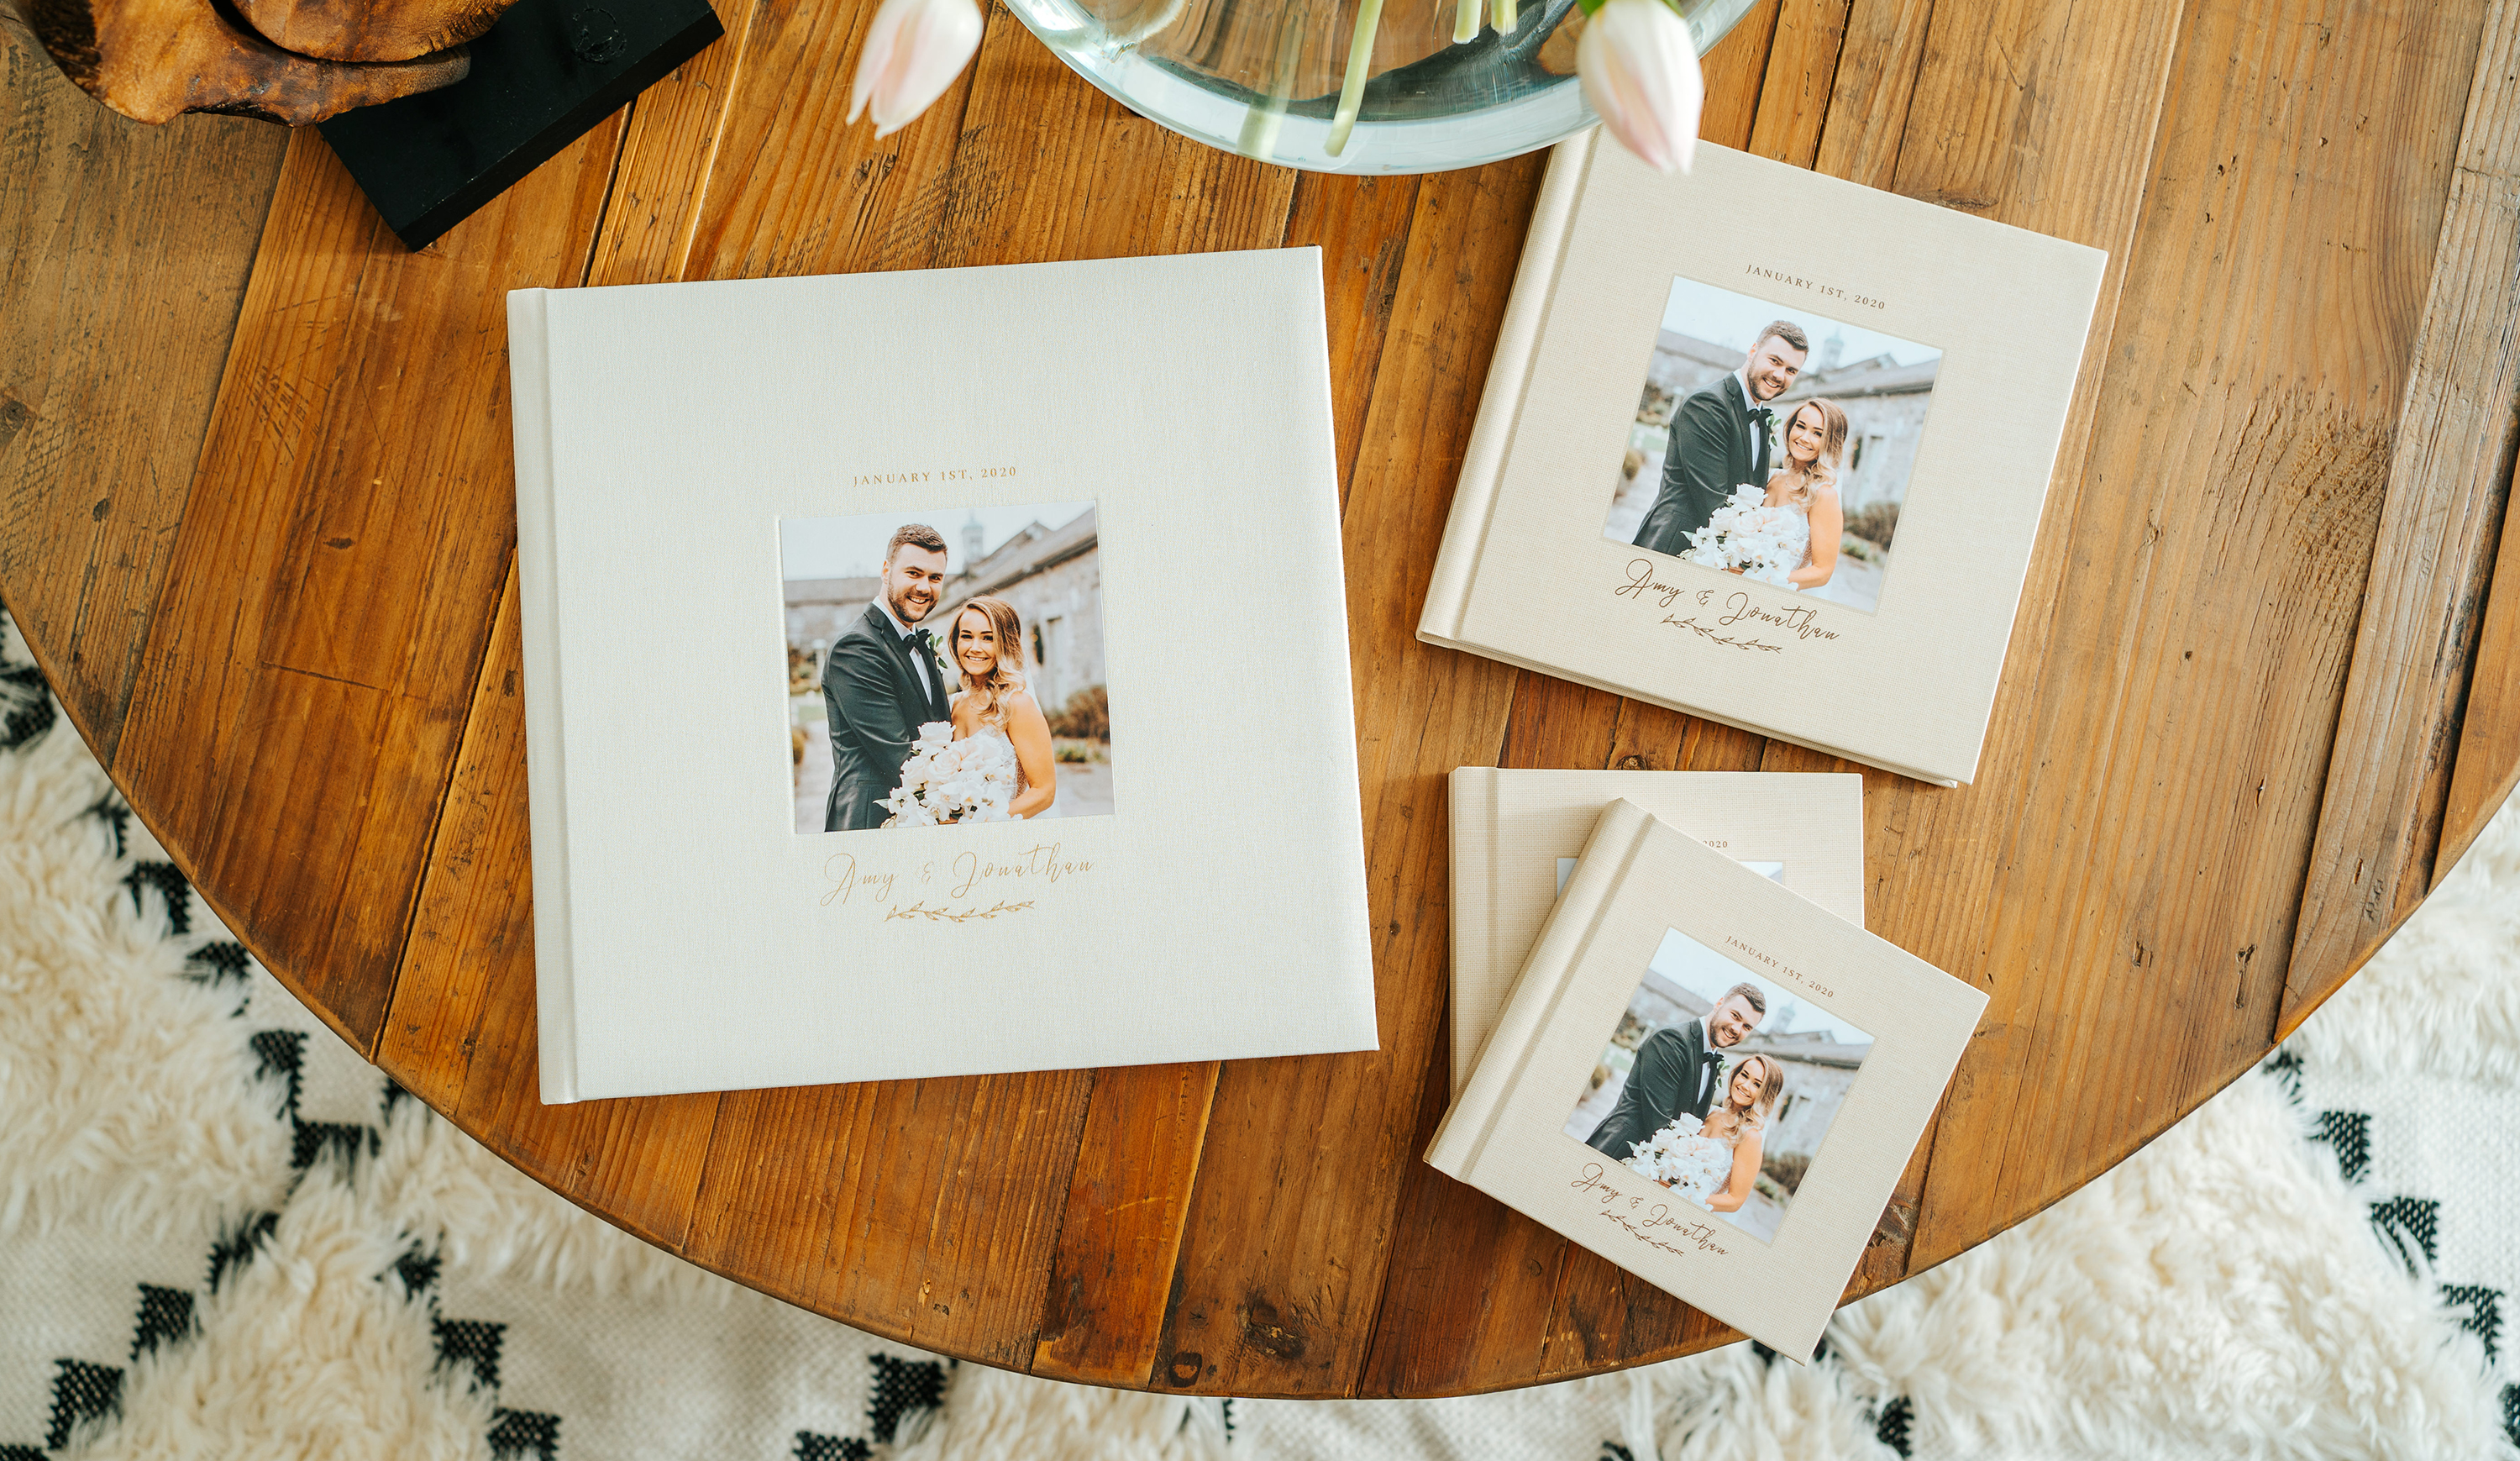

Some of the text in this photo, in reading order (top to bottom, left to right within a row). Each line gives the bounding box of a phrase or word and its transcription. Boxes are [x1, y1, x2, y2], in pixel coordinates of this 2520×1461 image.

[1746, 265, 1886, 310] JANUARY 1ST, 2020
[853, 466, 1016, 487] JANUARY 1ST, 2020
[1614, 558, 1840, 640] Amy & Jonathan
[820, 842, 1095, 907] Amy & Jonathan
[1725, 935, 1835, 998] JANUARY 1ST, 2020
[1571, 1162, 1729, 1255] Amy & Jonathan
